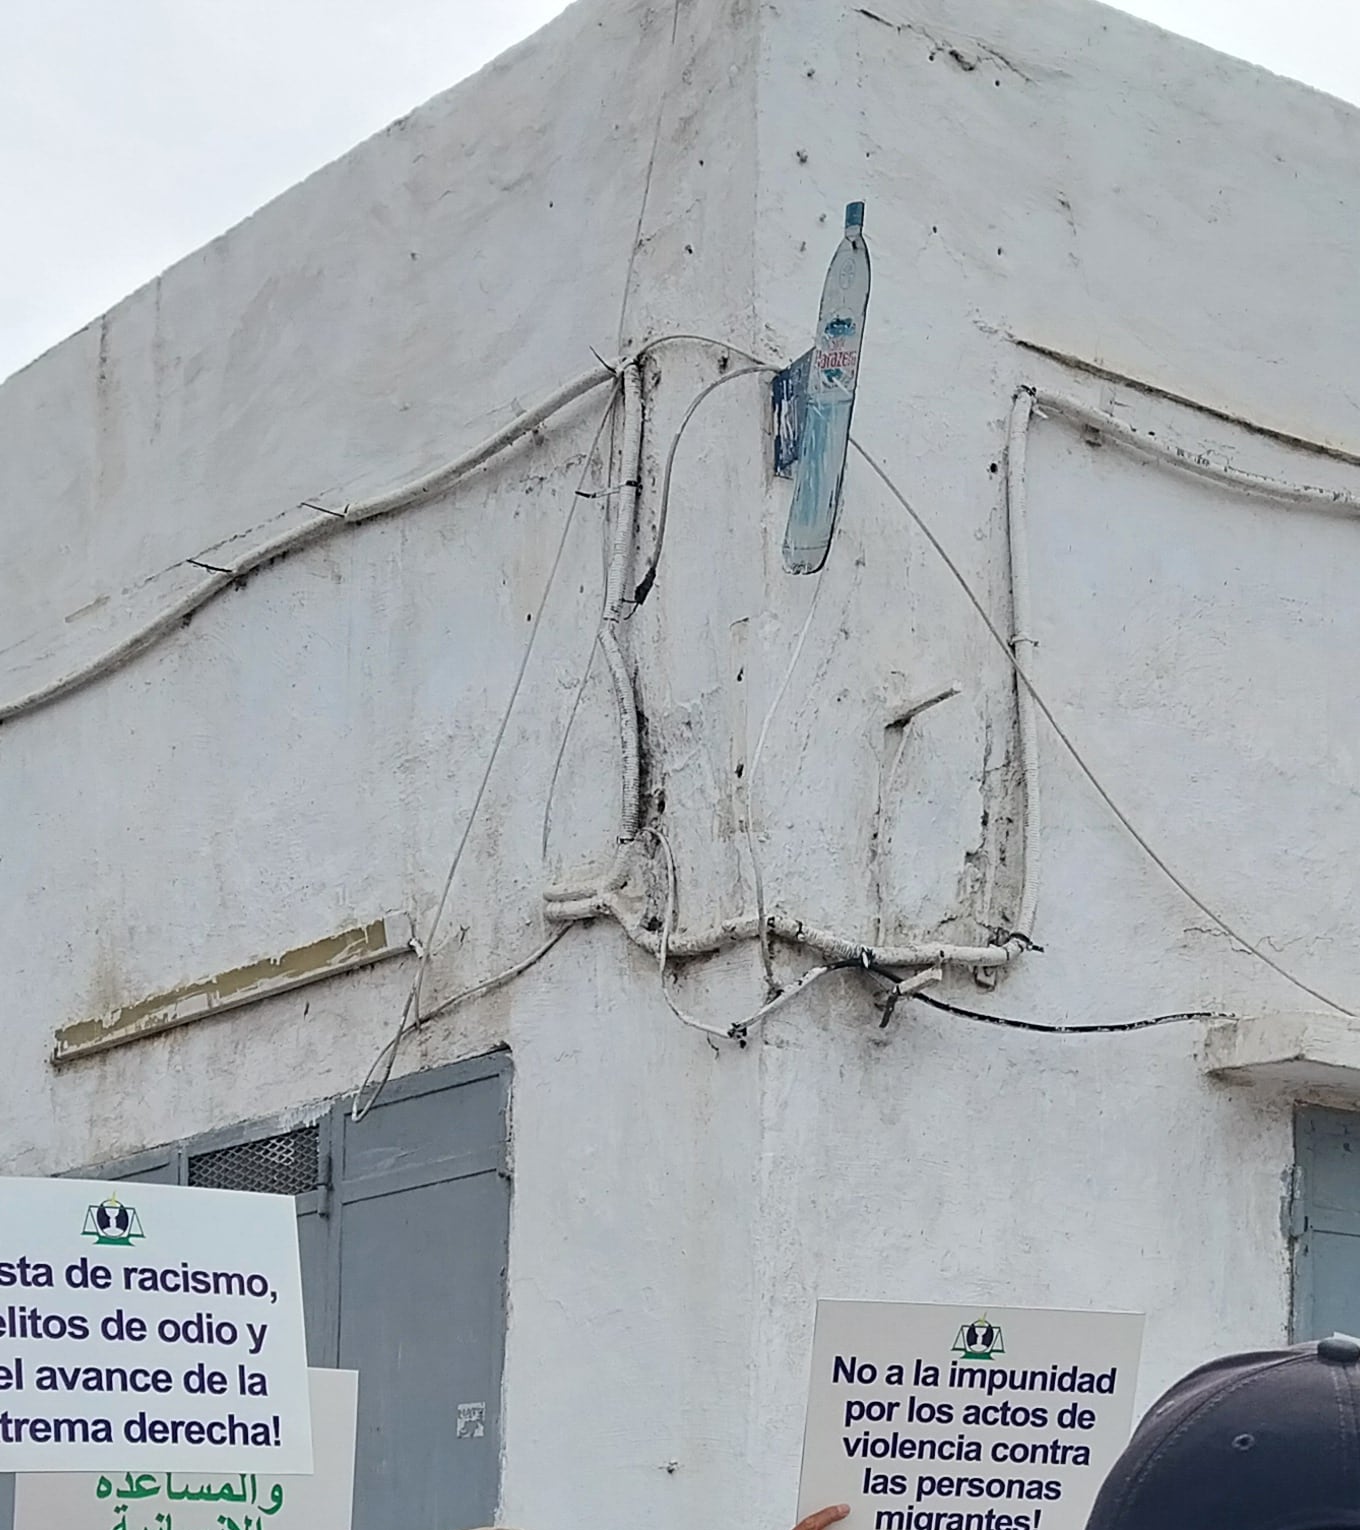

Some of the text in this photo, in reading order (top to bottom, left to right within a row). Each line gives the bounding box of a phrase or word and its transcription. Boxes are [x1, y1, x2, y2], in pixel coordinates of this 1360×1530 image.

[65, 1257, 112, 1290] de
[123, 1262, 277, 1304] racismo,
[100, 1309, 147, 1342] de
[157, 1312, 238, 1345] odio
[246, 1323, 268, 1355] y
[35, 1366, 173, 1393] avance
[183, 1362, 228, 1395] de
[238, 1364, 268, 1397] la
[832, 1355, 1117, 1396] No a la impunidad
[123, 1411, 281, 1447] derecha!
[844, 1395, 1096, 1430] por los actos de
[842, 1430, 1090, 1466] violencia contra
[862, 1467, 1062, 1503] las personas
